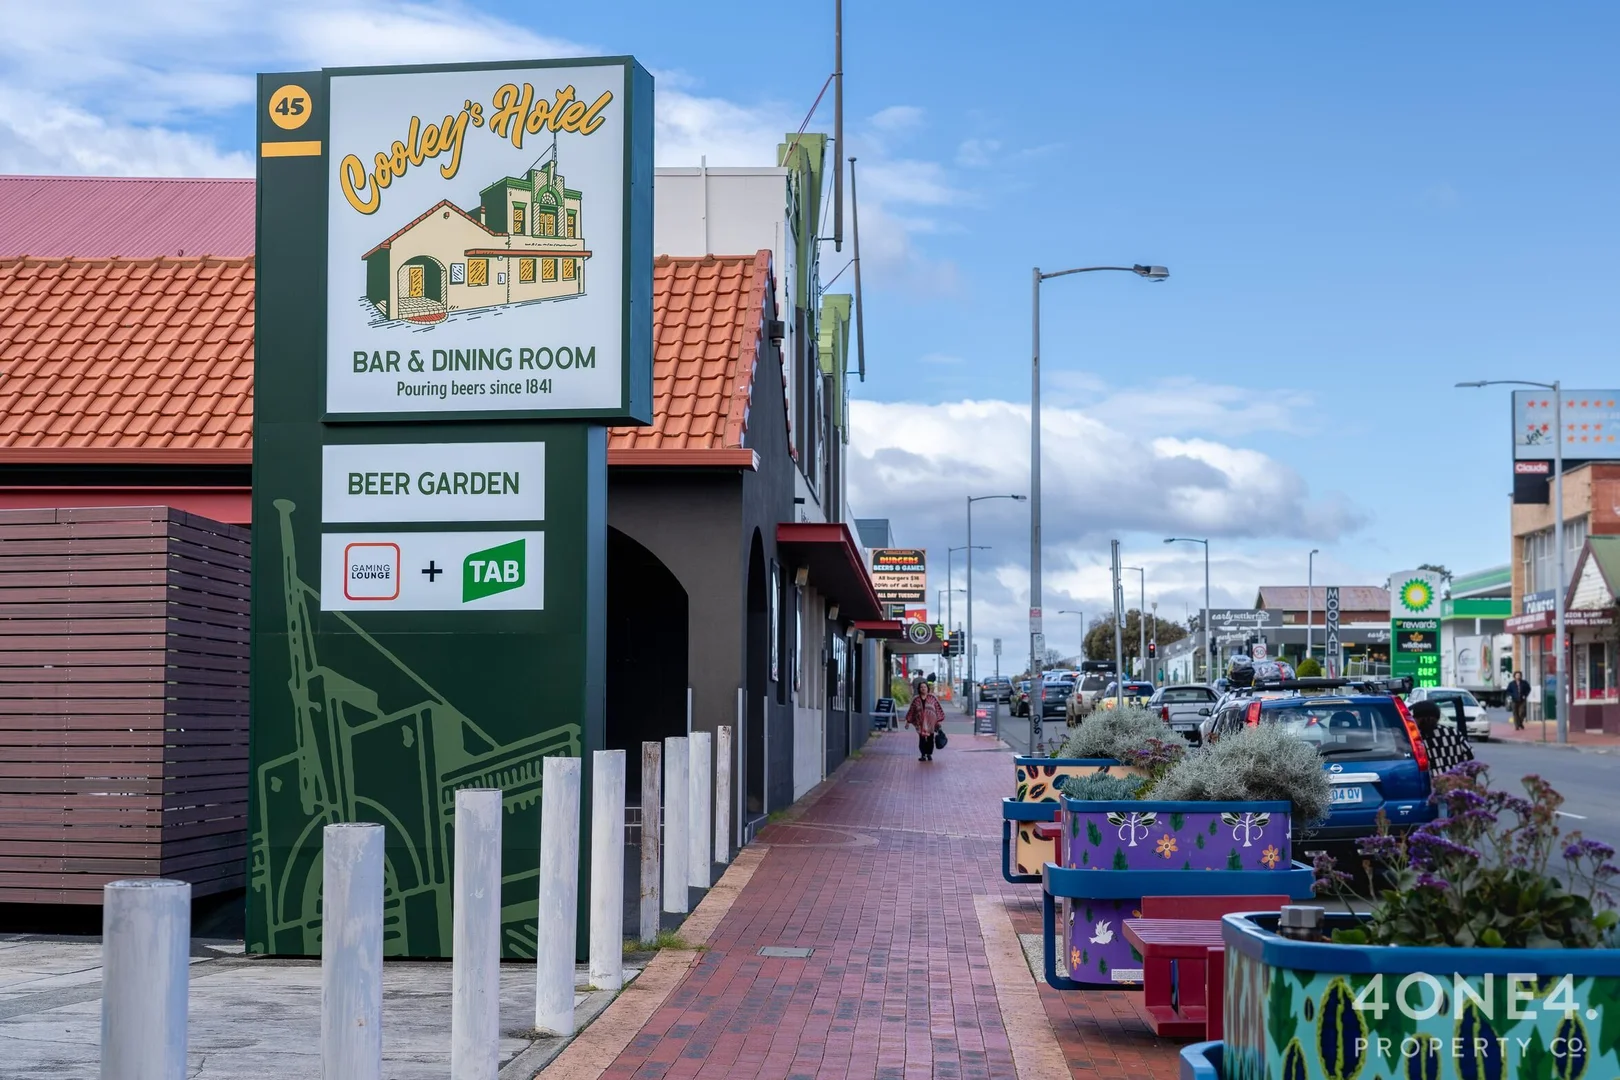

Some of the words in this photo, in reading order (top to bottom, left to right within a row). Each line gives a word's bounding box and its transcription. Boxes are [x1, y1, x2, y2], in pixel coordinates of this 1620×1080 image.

[275, 97, 305, 116] 45
[339, 99, 484, 215] Cooley's
[489, 82, 613, 148] Hotel
[353, 350, 400, 373] BAR
[407, 349, 425, 372] &
[432, 347, 513, 371] DINING
[519, 346, 596, 370] ROOM
[397, 381, 447, 399] Pouring
[451, 379, 486, 396] beers
[490, 379, 522, 395] since
[525, 378, 552, 394] 1841
[348, 472, 410, 495] BEER
[418, 471, 519, 495] GARDEN
[351, 564, 391, 572] GAMING
[879, 556, 919, 564] BURGERS
[469, 560, 520, 583] TAB
[1211, 610, 1234, 626] early
[1327, 588, 1339, 655] MOONAH
[1402, 619, 1437, 629] rewards
